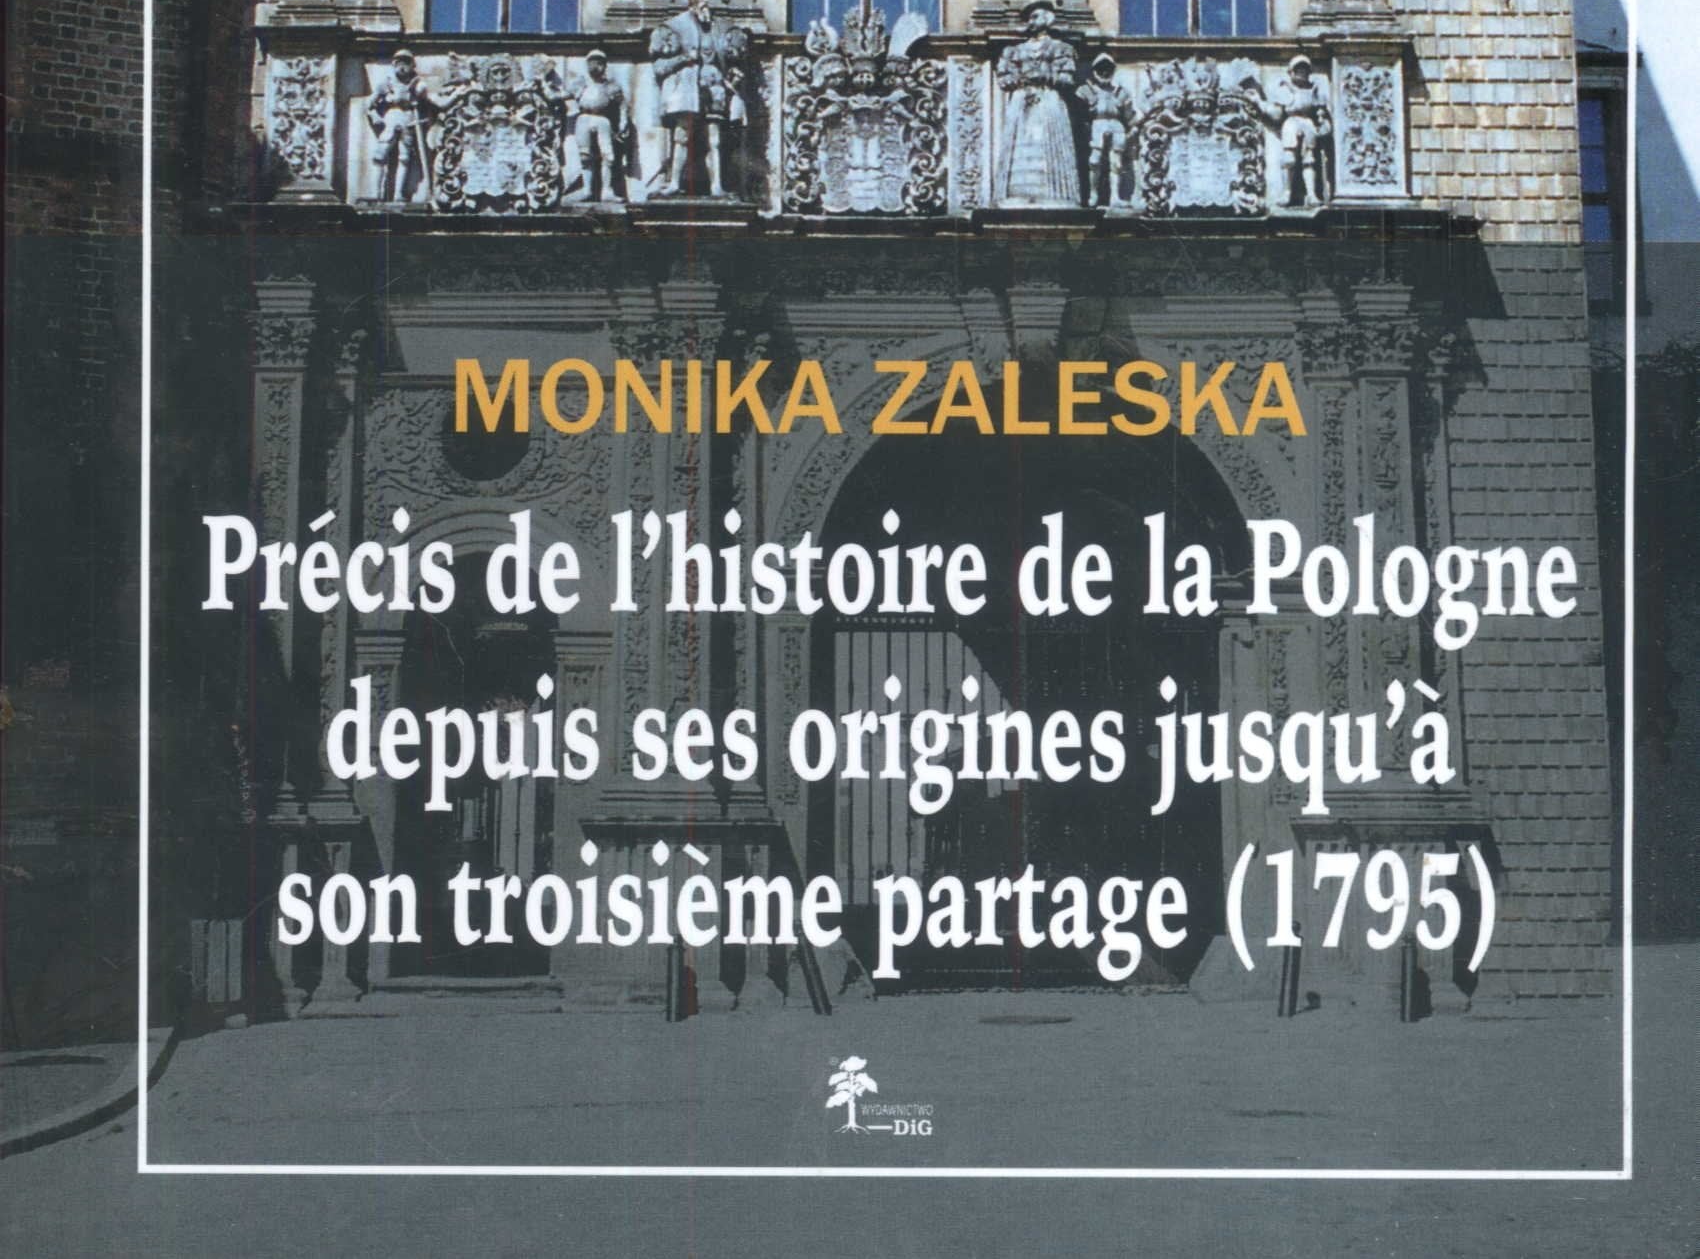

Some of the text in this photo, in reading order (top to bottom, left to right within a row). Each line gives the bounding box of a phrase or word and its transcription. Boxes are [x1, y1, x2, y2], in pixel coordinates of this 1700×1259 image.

[455, 358, 1307, 436] MONIKA ZALESKA
[201, 506, 1578, 652] Précis de l’histoire de la Pologne
[326, 673, 1457, 816] depuis ses origines jusqu’à
[277, 839, 1496, 982] son troisième partage (1795)
[893, 1119, 933, 1136] DiG
